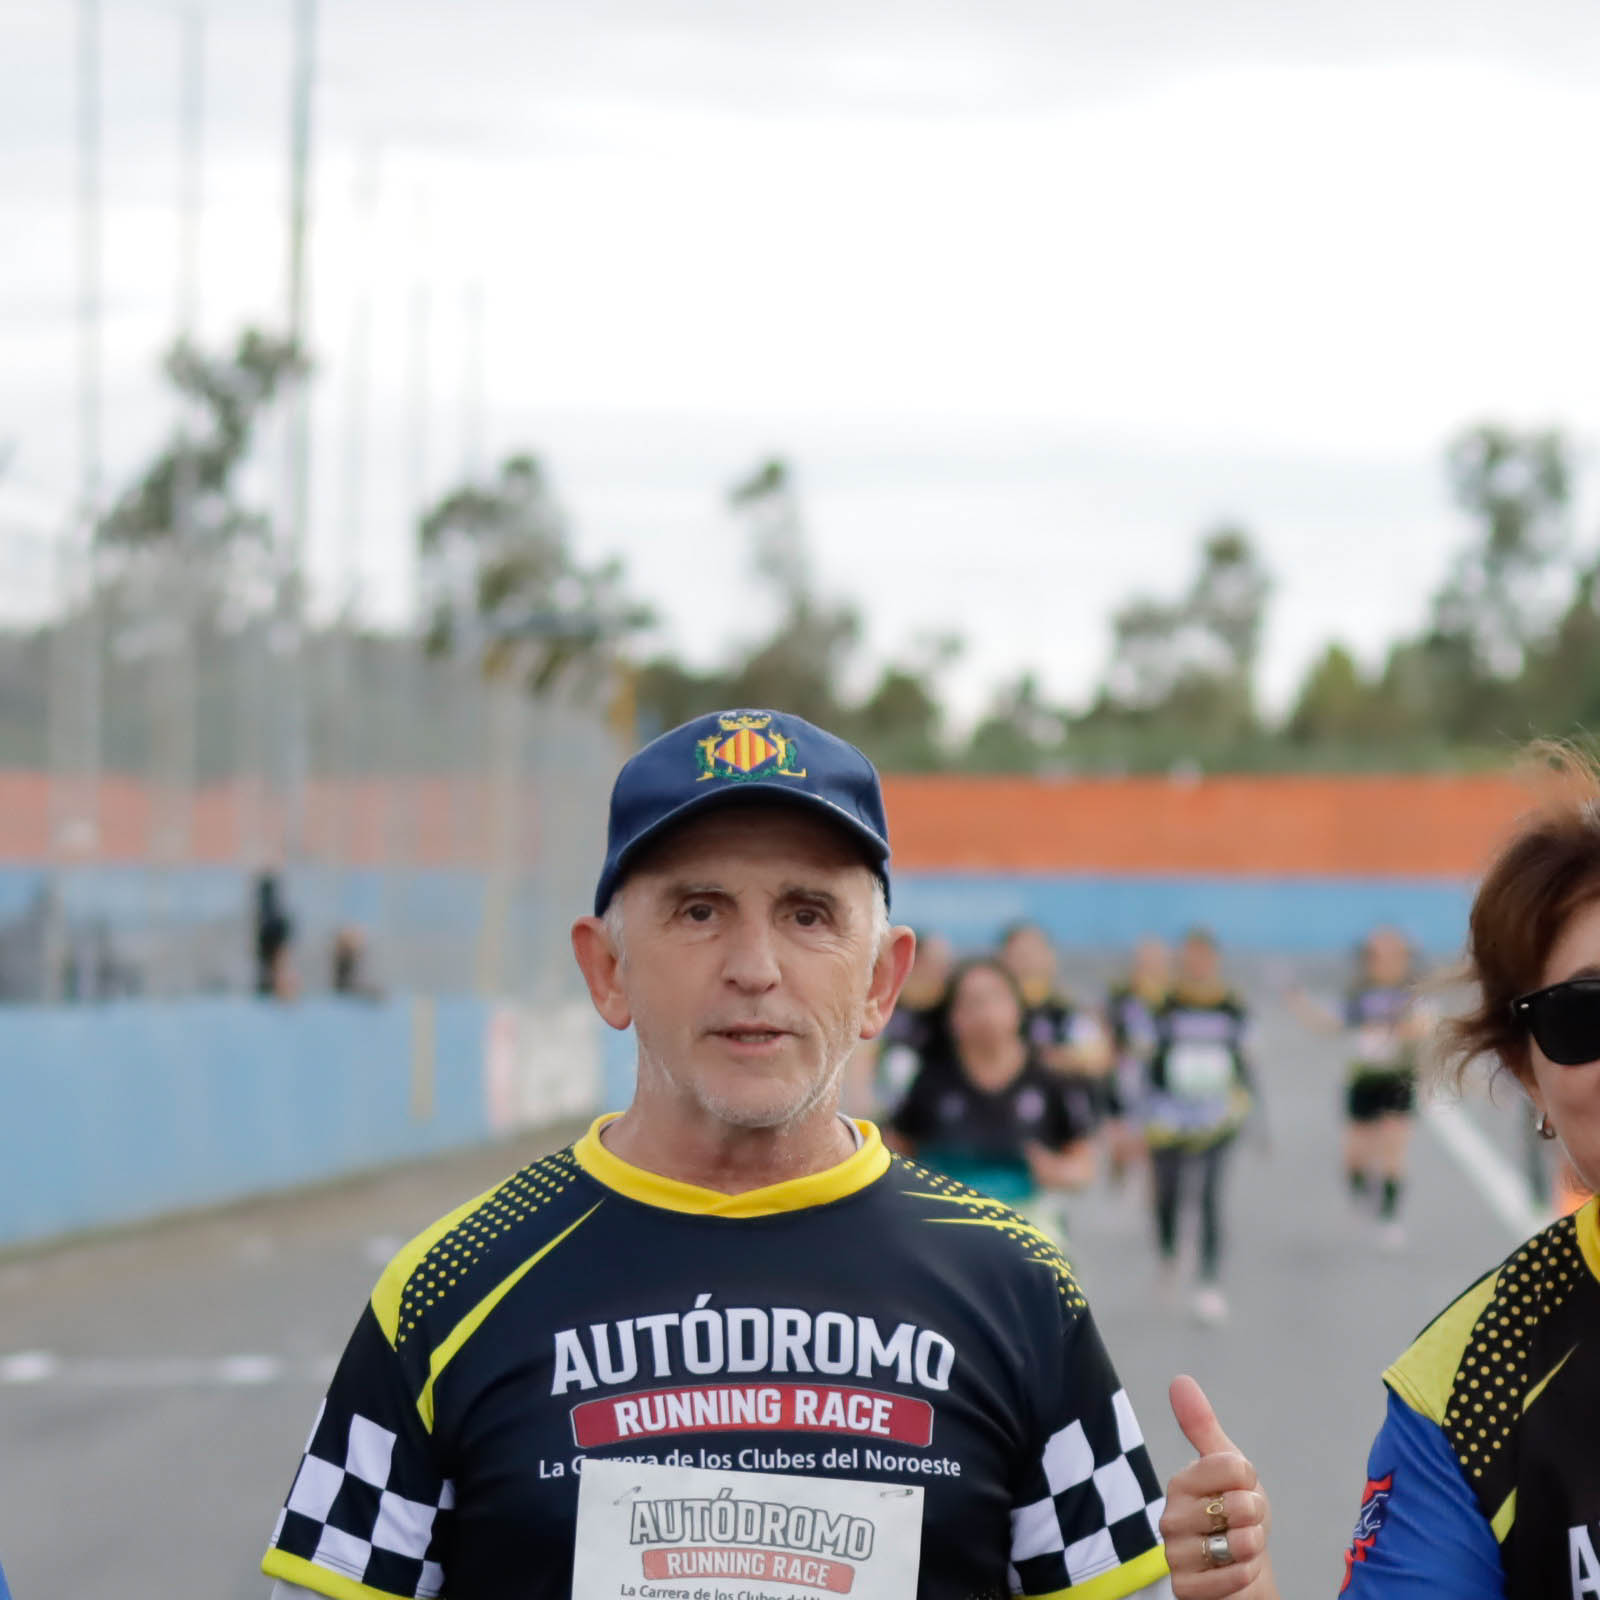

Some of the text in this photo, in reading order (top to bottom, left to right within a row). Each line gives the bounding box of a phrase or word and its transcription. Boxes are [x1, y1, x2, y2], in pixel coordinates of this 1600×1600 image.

[551, 1293, 956, 1396] AUTÓDROMO
[613, 1388, 893, 1437] RUNNING RACE
[539, 1459, 565, 1479] La
[665, 1449, 693, 1468] de
[700, 1449, 732, 1469] los
[738, 1448, 816, 1469] Clubes
[822, 1448, 858, 1469] del
[865, 1450, 961, 1477] Noroeste
[630, 1487, 875, 1562] AUTÓDROMO
[666, 1551, 831, 1588] RUNNING RACE
[620, 1583, 636, 1597] La
[639, 1585, 690, 1600] Carrera
